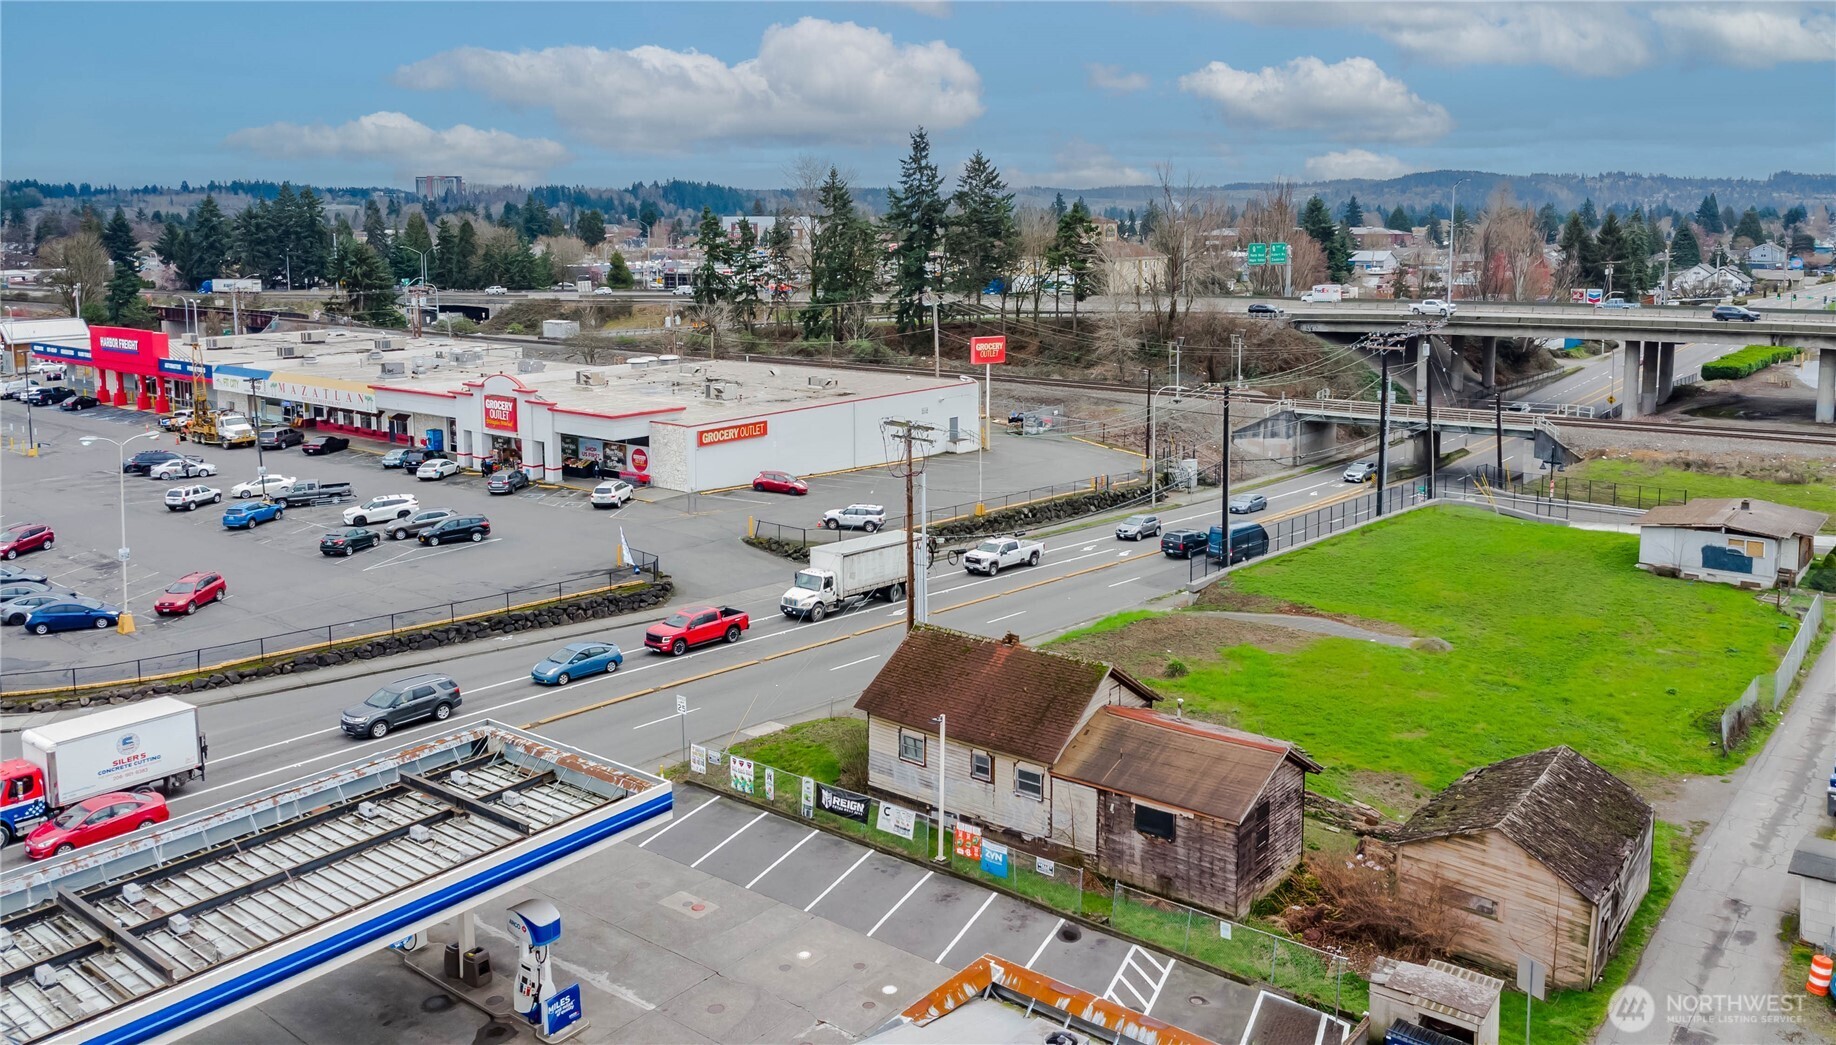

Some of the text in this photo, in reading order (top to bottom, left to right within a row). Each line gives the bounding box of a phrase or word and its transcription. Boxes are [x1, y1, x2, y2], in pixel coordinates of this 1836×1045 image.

[100, 336, 139, 350] HARBOR FREIGHT
[975, 341, 1003, 351] GROCERY
[980, 349, 998, 357] OUTLET
[278, 382, 364, 404] MAZATLAN
[485, 399, 513, 412] GROCERY
[489, 409, 509, 421] OUTLET
[702, 422, 765, 445] GROCERY OUTLET
[97, 763, 133, 776] CONCRETE
[133, 754, 162, 766] CUTTING
[832, 796, 865, 813] REIGN
[985, 849, 1003, 863] ZYN
[548, 994, 571, 1015] MILES
